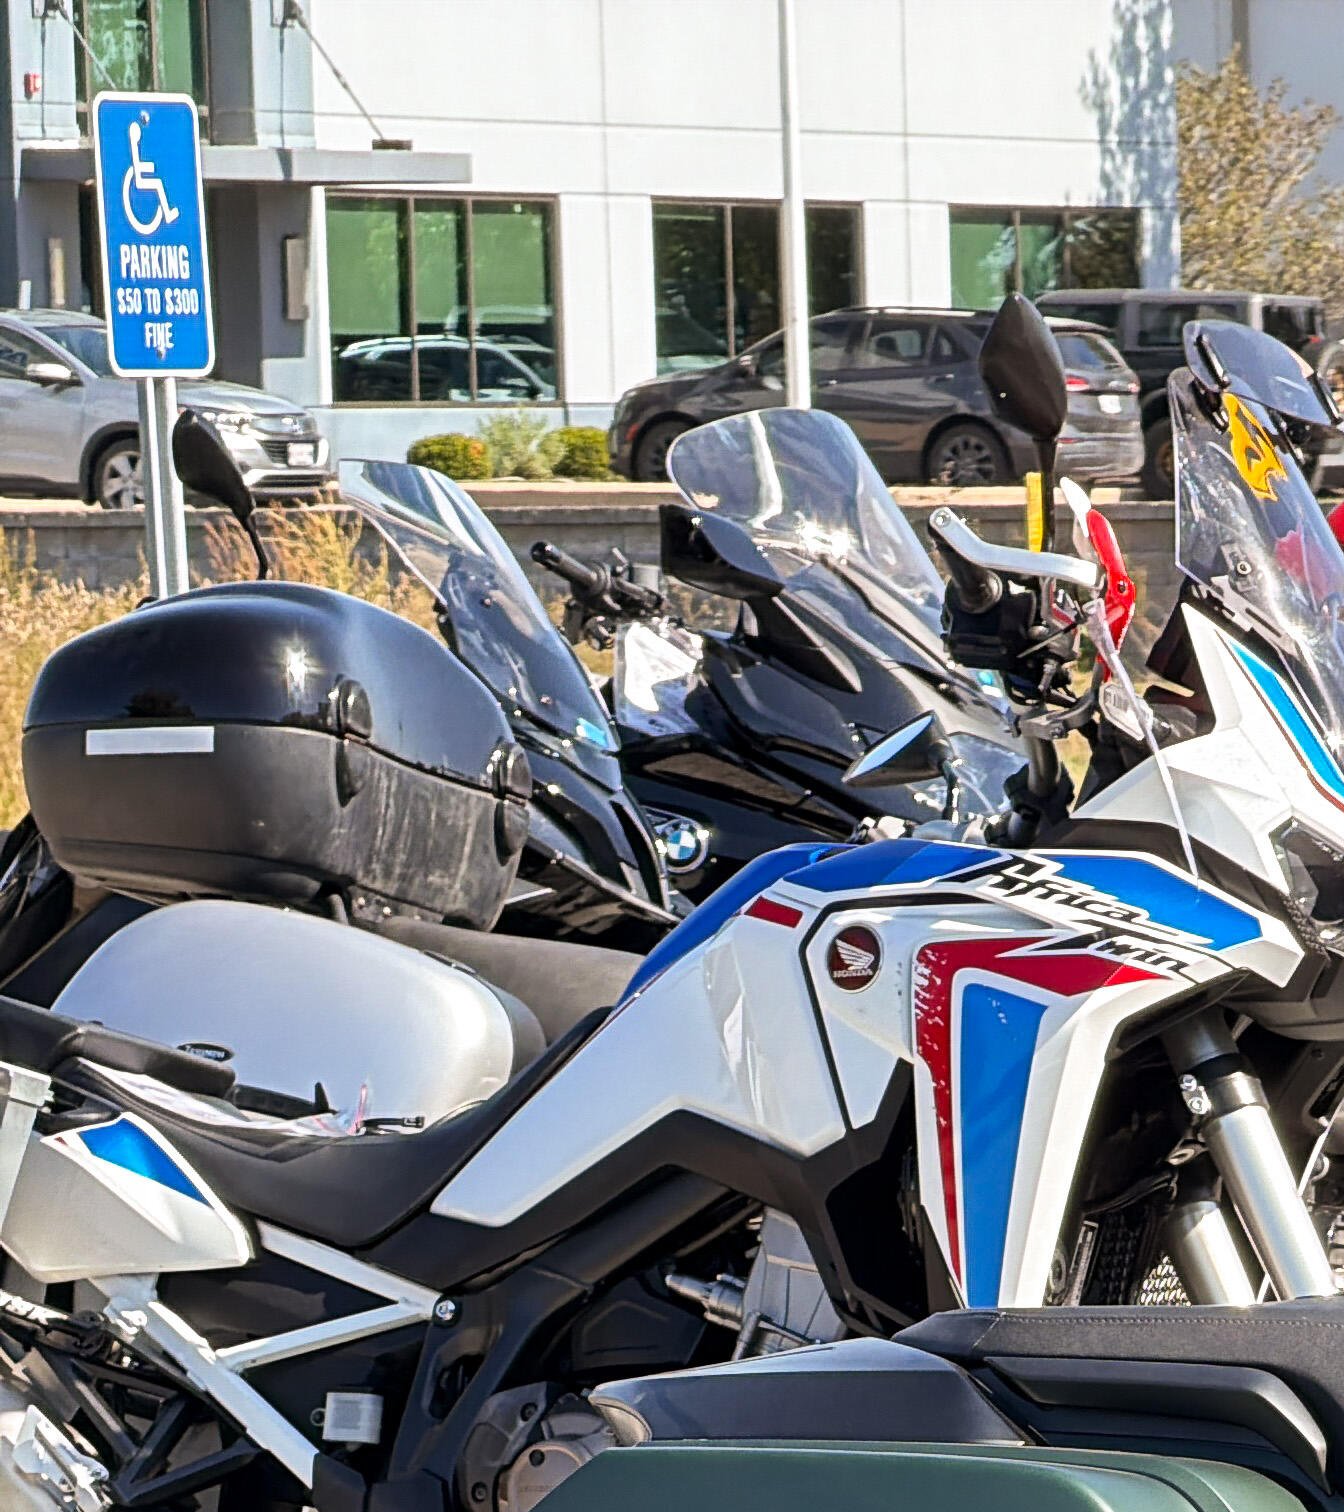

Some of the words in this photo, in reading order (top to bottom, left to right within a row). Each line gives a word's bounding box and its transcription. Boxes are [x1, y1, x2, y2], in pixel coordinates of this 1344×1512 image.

[120, 244, 190, 279] PARKING
[116, 287, 142, 315] $50
[144, 287, 161, 315] TO
[164, 287, 199, 315] $300
[144, 321, 174, 349] FINE
[990, 855, 1145, 926] Africa
